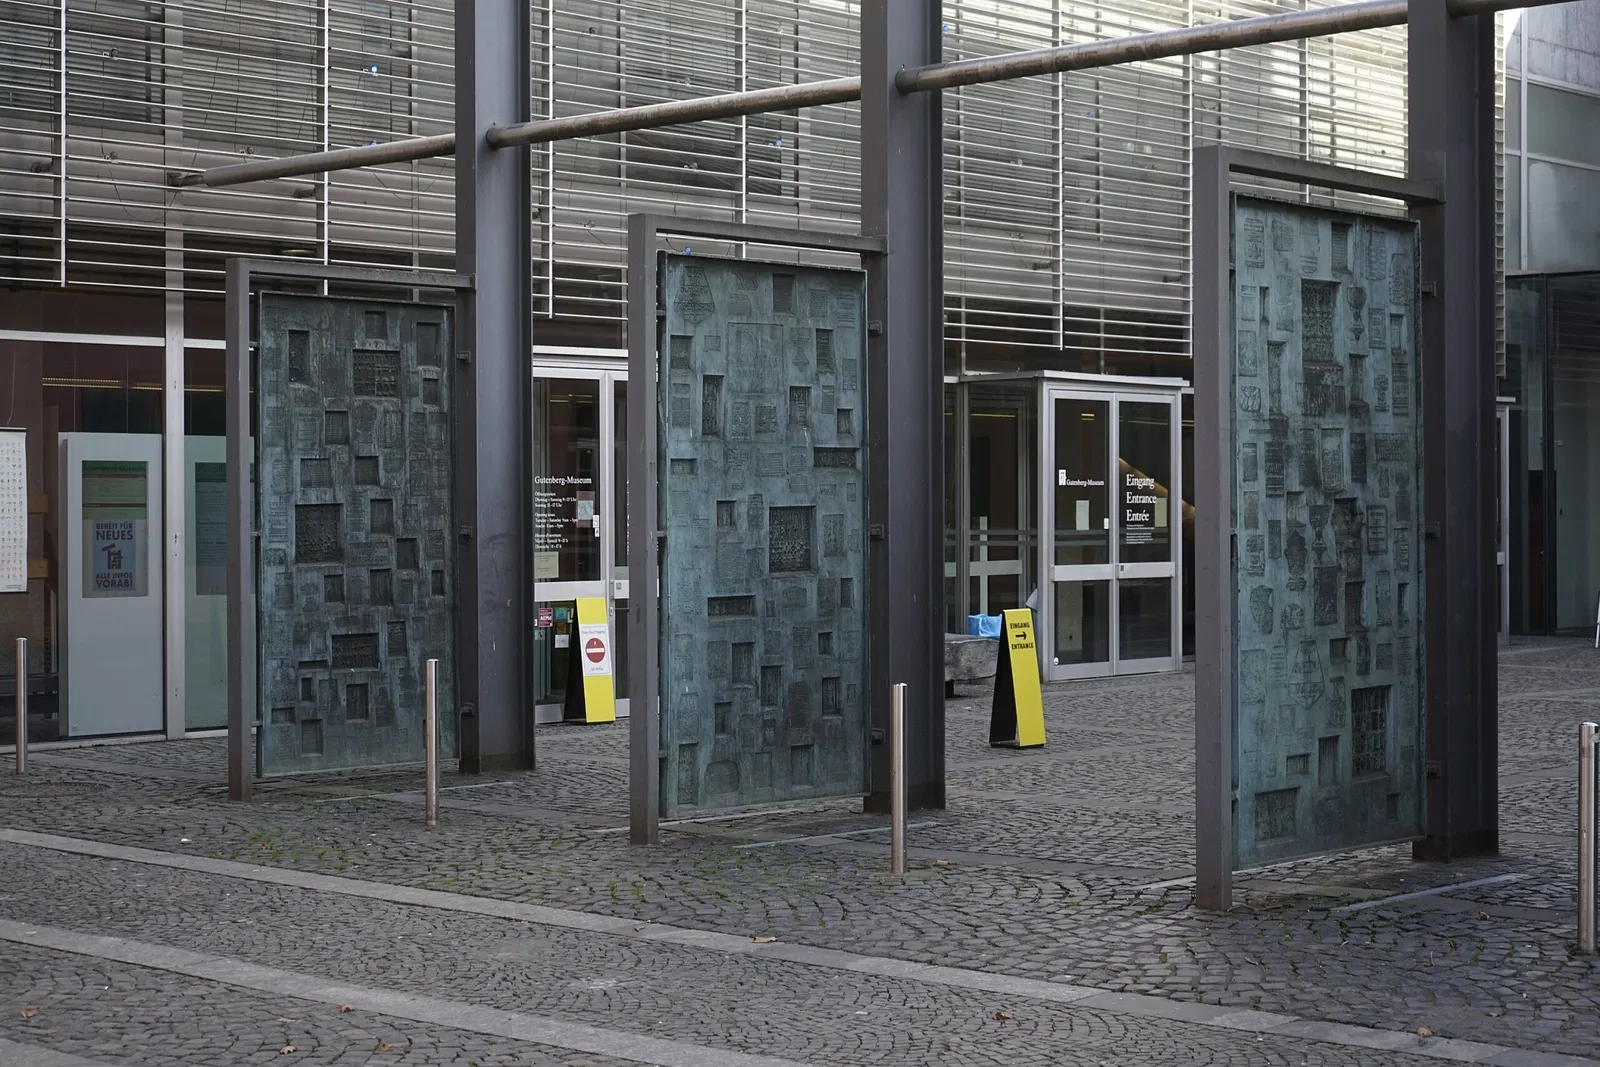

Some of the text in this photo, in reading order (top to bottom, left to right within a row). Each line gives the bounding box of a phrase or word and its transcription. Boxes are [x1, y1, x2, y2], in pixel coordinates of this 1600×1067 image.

[534, 476, 592, 486] Gutenberg-Museum
[1066, 479, 1105, 487] Gutenberg-Museum
[1126, 474, 1155, 490] Eingang
[1126, 492, 1157, 504] Entrance
[1126, 509, 1150, 522] Entrée
[120, 522, 133, 530] FÜR
[96, 530, 134, 540] NEUES
